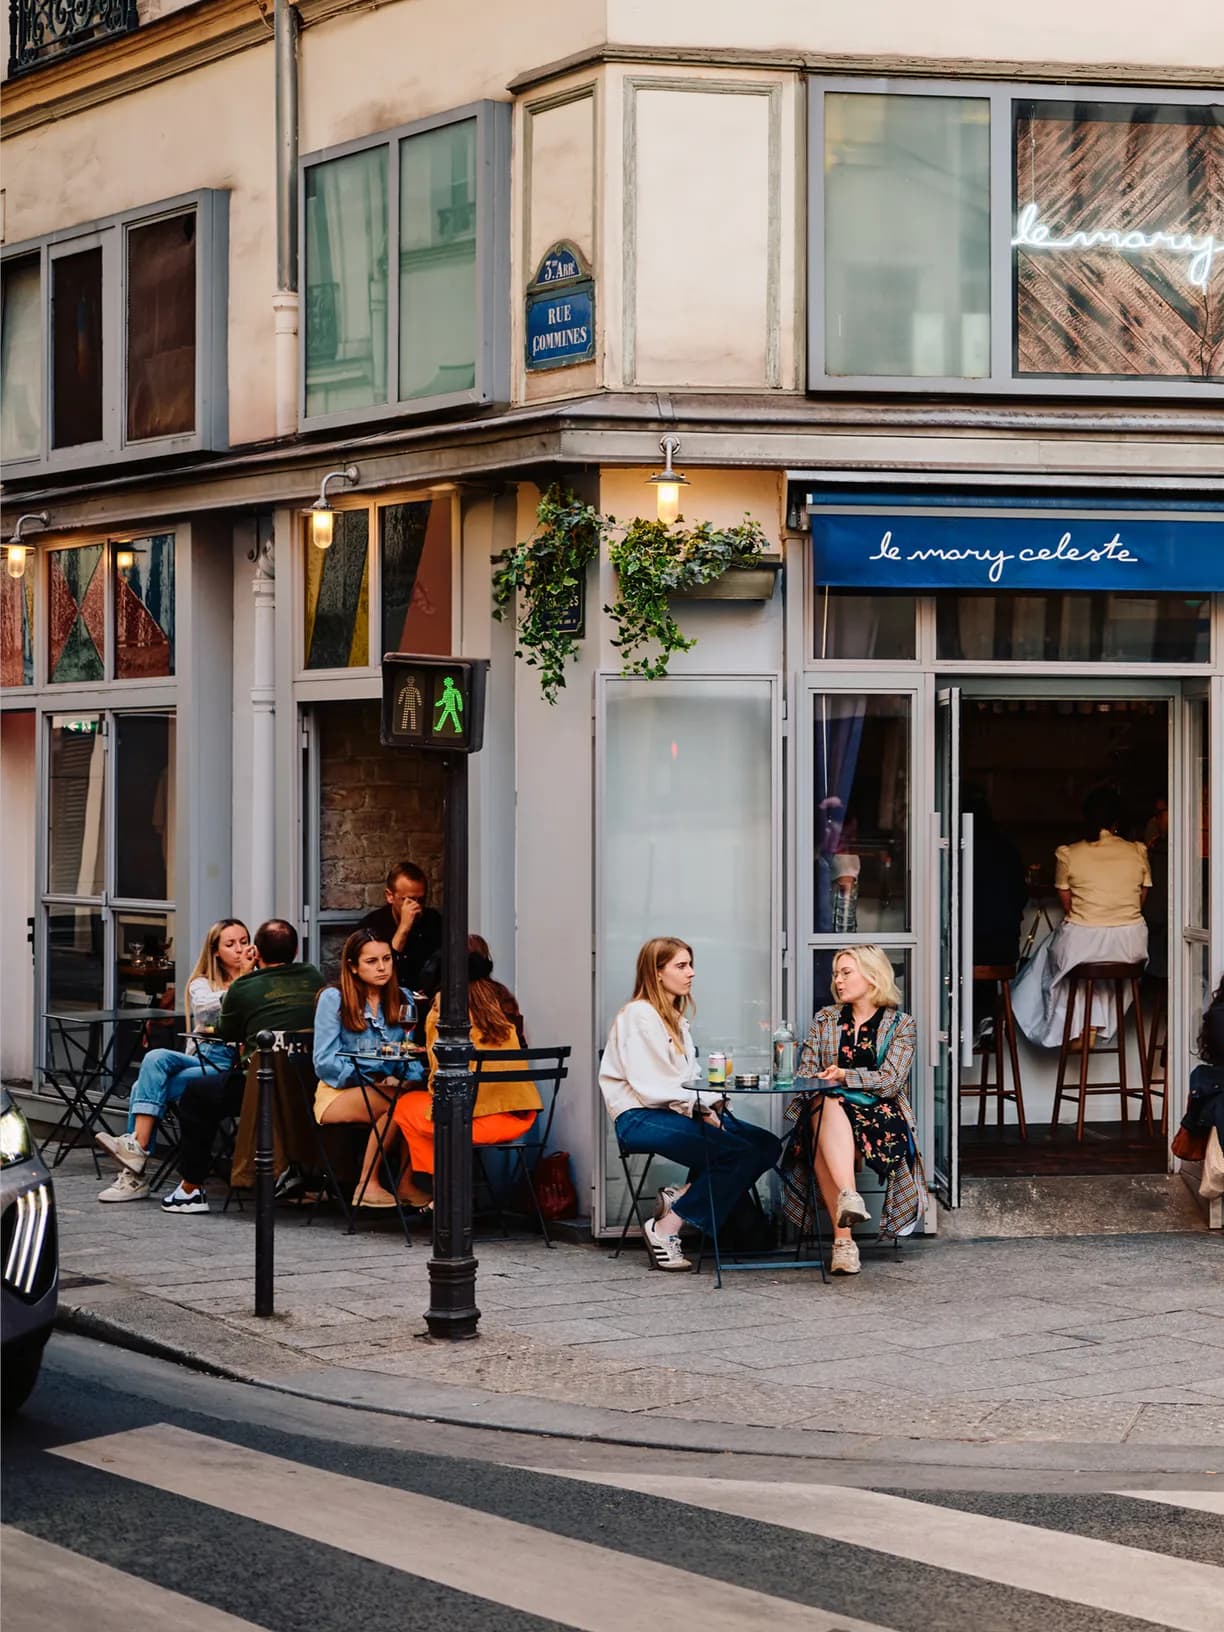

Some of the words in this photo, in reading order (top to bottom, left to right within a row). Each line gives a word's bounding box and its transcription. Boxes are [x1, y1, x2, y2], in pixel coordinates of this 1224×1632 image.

[1011, 203, 1060, 248] le
[547, 304, 572, 325] RUE
[532, 326, 587, 356] COMMINES
[869, 531, 902, 561] le
[907, 548, 1015, 583] mary
[1018, 532, 1138, 562] celeste
